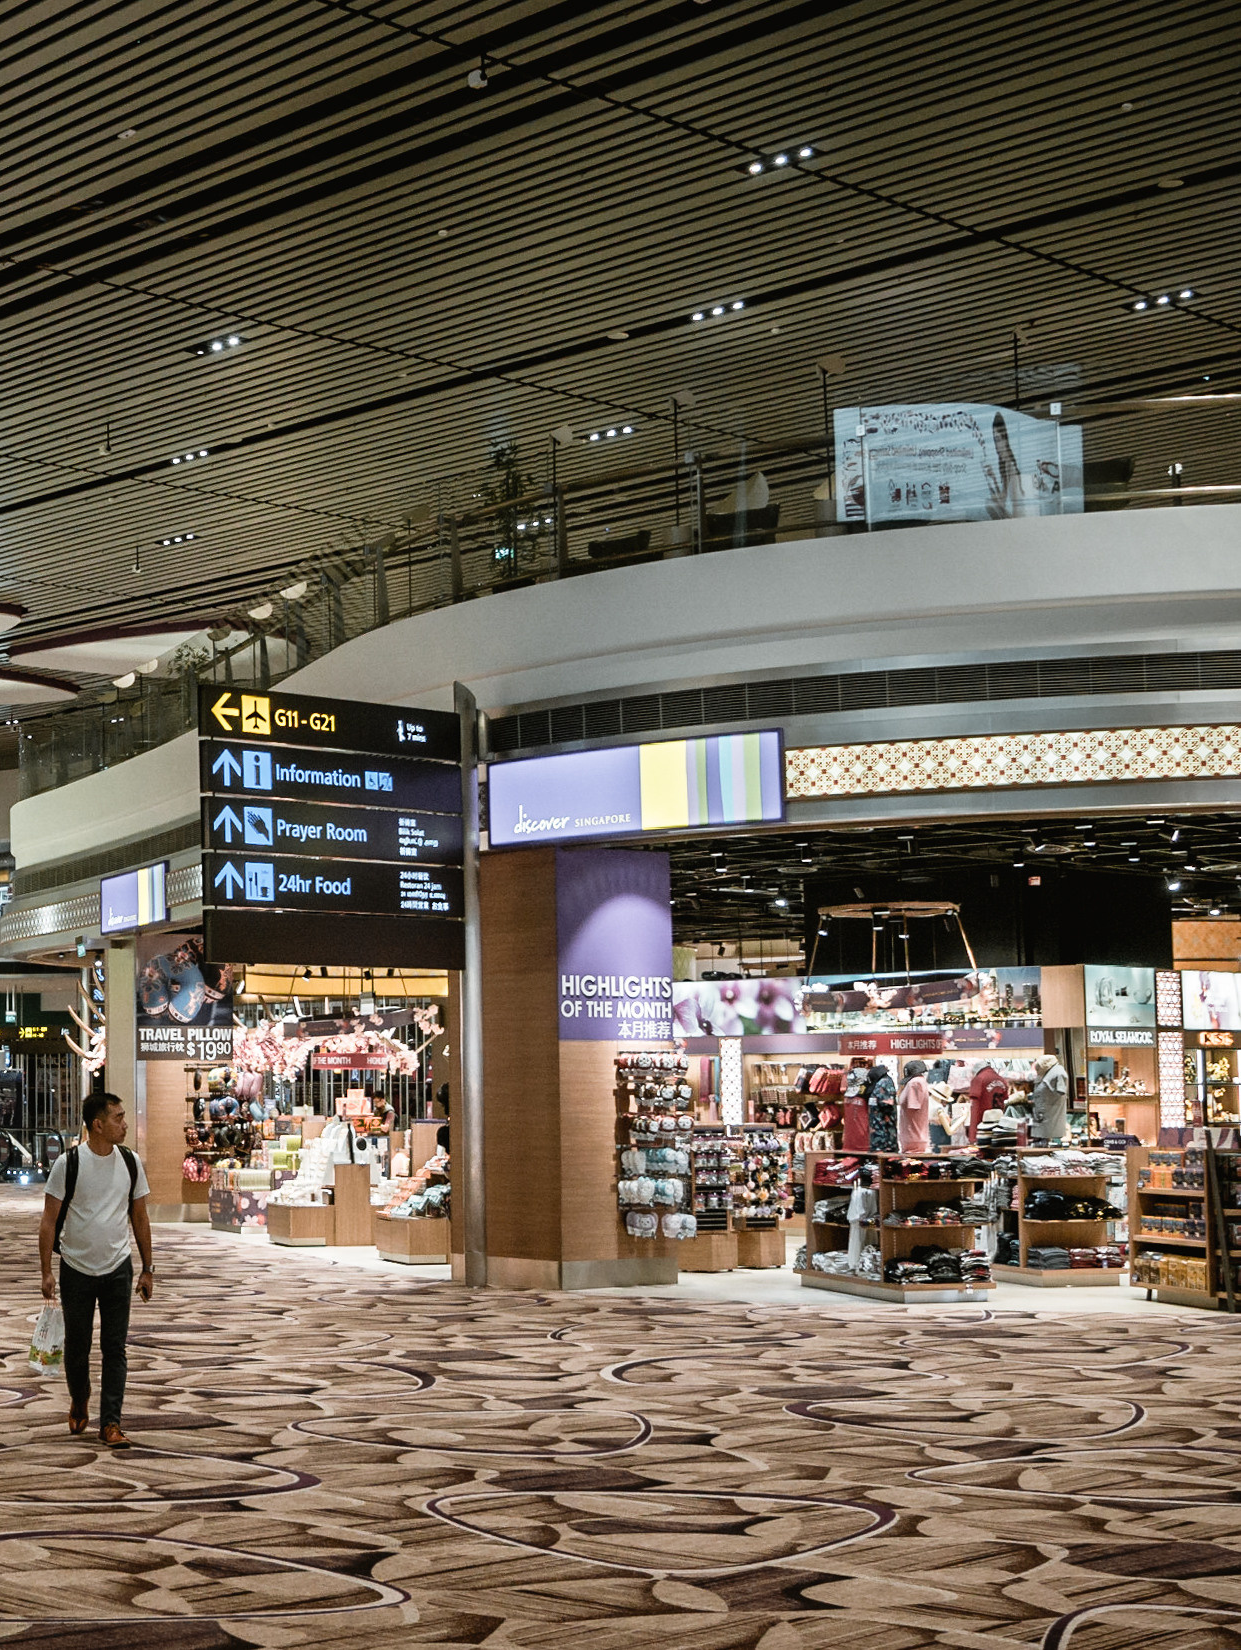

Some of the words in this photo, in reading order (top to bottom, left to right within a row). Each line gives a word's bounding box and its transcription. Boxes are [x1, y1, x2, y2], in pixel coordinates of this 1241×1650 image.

[275, 764, 361, 788] Information
[276, 818, 323, 842] Prayer
[326, 822, 368, 843] Room
[513, 804, 570, 834] discover
[574, 813, 631, 828] SINGAPORE
[278, 873, 312, 893] 24hr
[315, 876, 351, 896] Food
[561, 974, 673, 999] HIGHLIGHTS
[560, 1000, 583, 1018] OF
[586, 1000, 613, 1018] THE
[616, 1001, 673, 1019] MONTH
[139, 1028, 185, 1041] TRAVEL
[188, 1028, 231, 1041] PILLOW
[617, 1020, 672, 1039] 本月推荐
[890, 1038, 936, 1050] HIGHLIGHTS
